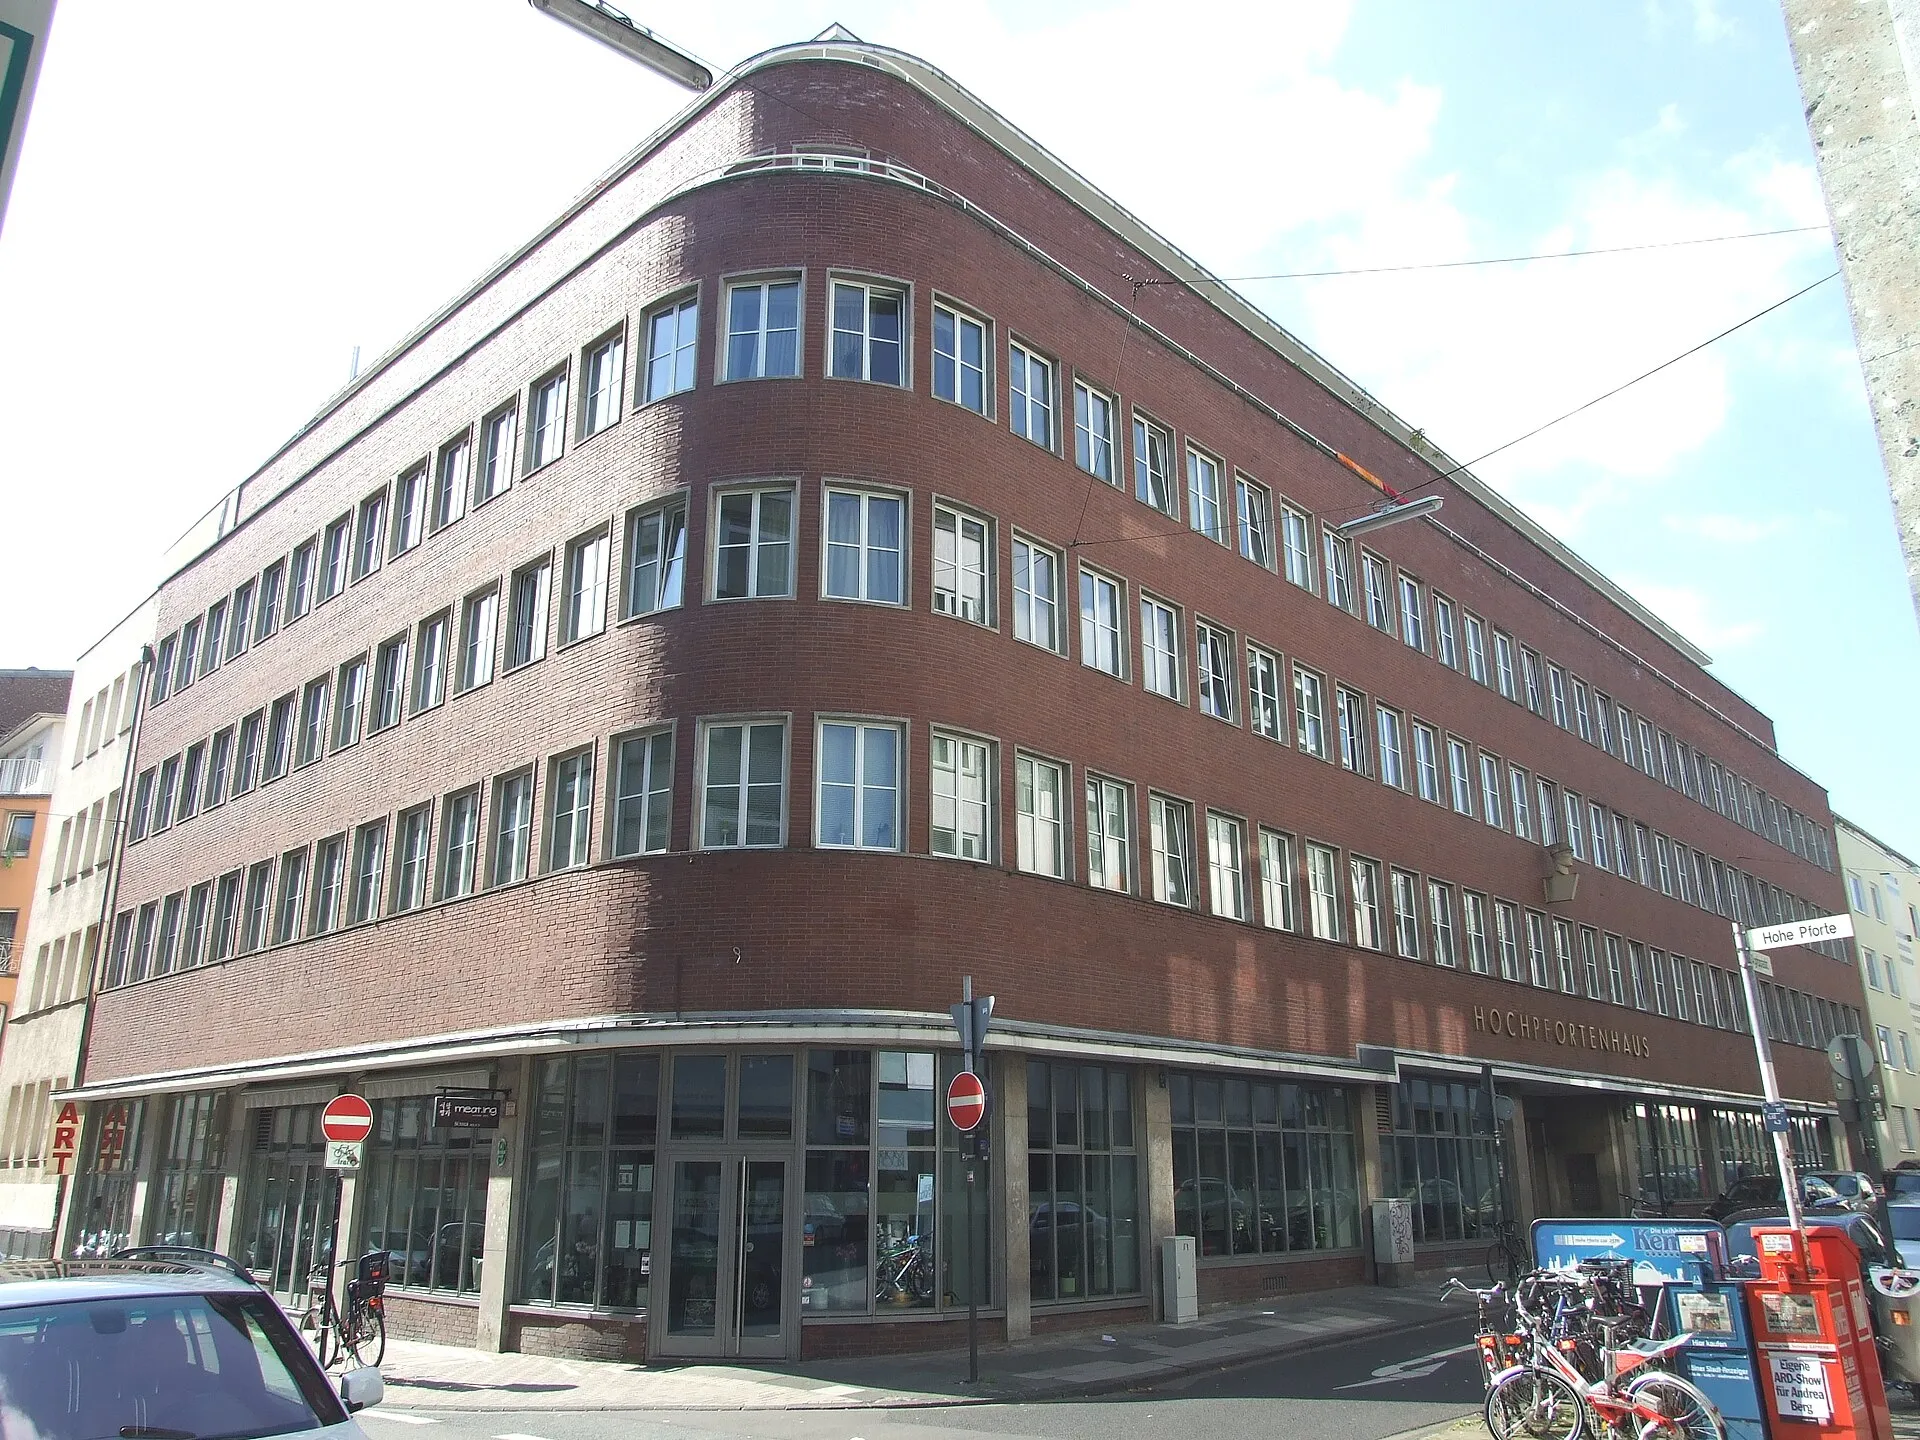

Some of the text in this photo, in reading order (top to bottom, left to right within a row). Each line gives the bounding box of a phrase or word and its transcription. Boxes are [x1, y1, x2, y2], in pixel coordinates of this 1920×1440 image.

[1763, 923, 1837, 944] Hohe Pforte
[1474, 1005, 1650, 1058] HOCHPFORTENHAUS
[52, 1102, 79, 1174] ART
[1780, 1359, 1810, 1372] Eigene
[1774, 1371, 1821, 1386] ARD-Show
[1776, 1386, 1825, 1400] für Andrea
[1790, 1400, 1814, 1415] Berg
